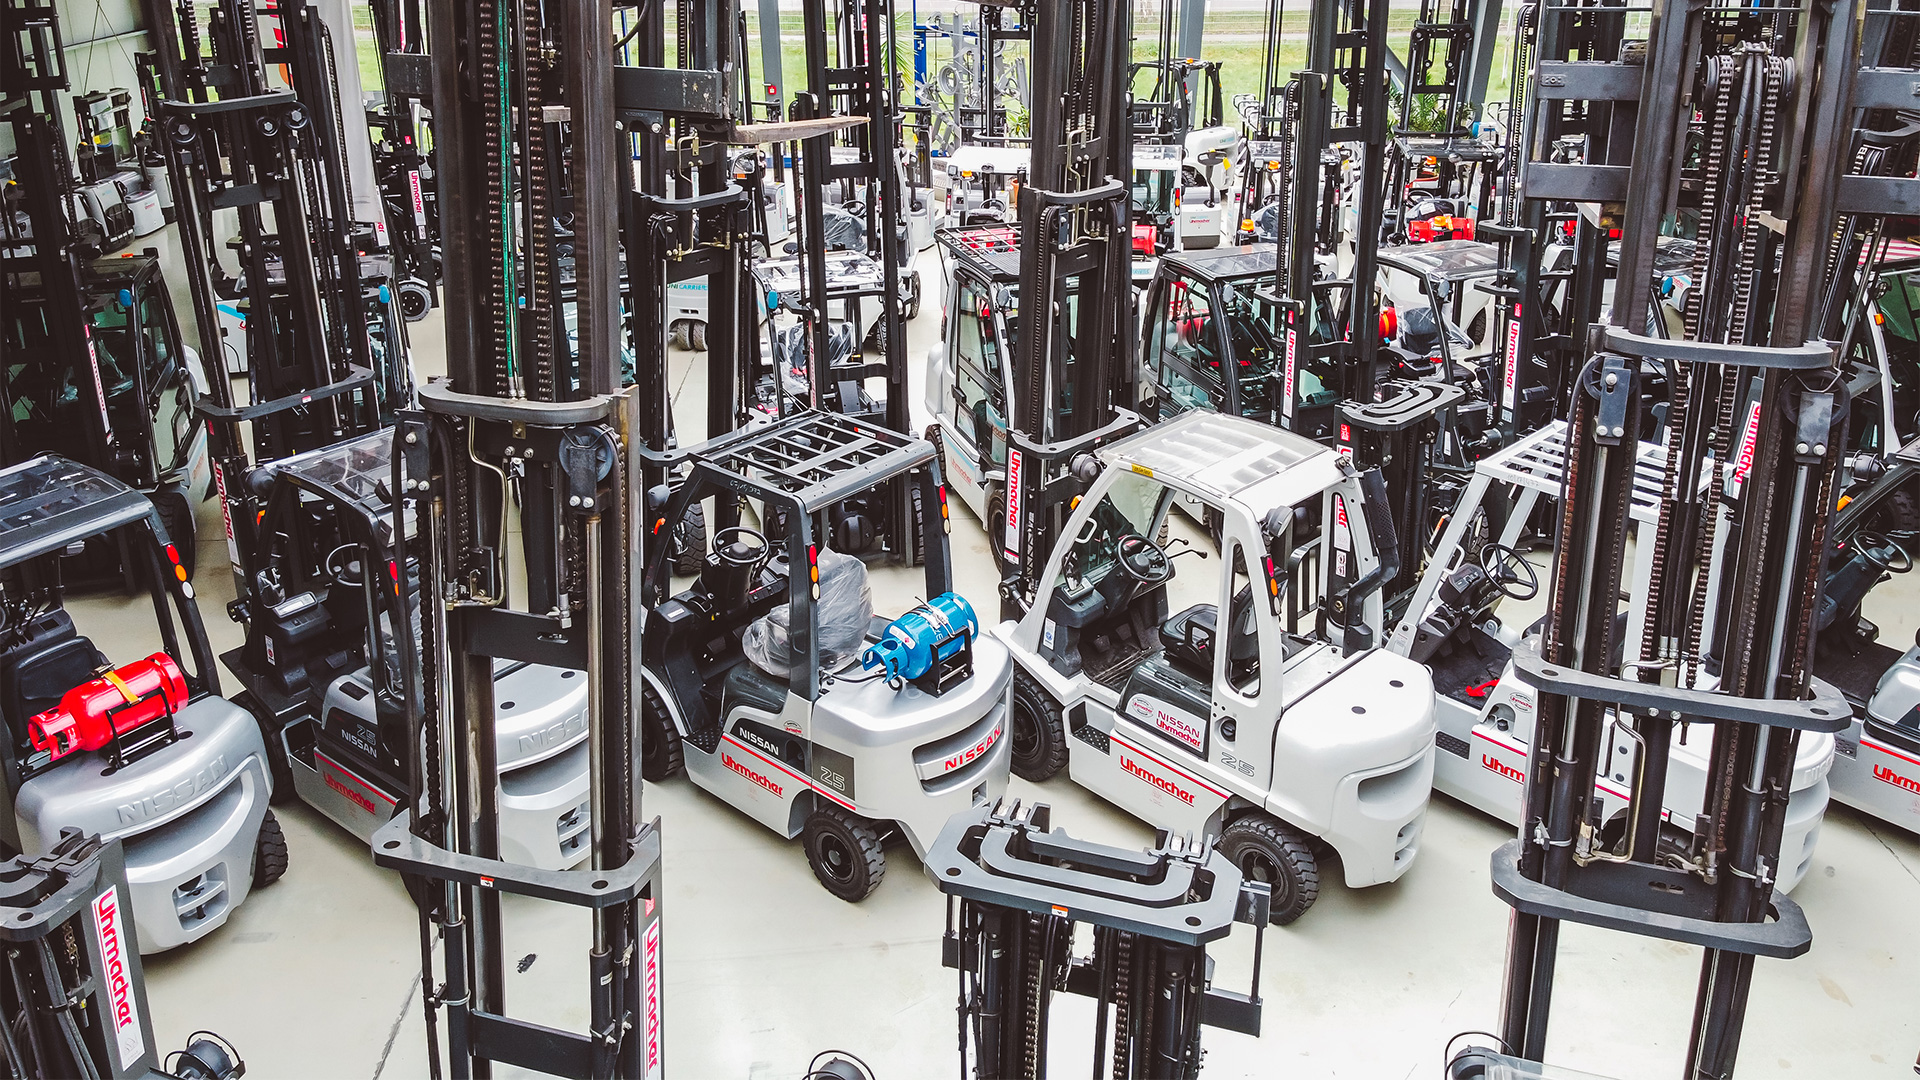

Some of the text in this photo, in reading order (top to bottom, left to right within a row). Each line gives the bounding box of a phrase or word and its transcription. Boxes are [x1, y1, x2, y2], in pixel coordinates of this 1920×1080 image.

[1284, 331, 1296, 398] Uhrmacher
[1506, 322, 1519, 390] Uhrmacher
[1009, 450, 1021, 530] Uhrmacher
[340, 728, 378, 759] NISSAN
[355, 723, 378, 747] 25
[739, 726, 779, 756] NISSAN
[944, 724, 1001, 771] NISSAN
[1155, 718, 1201, 748] Uhrmacher
[1157, 709, 1201, 739] NISSAN
[721, 751, 784, 799] Uhrmacher
[819, 765, 847, 793] 25
[1120, 754, 1196, 806] Uhrmacher
[1220, 751, 1255, 778] 25
[116, 753, 230, 824] NISSAN
[322, 770, 377, 814] Uhrmacher
[98, 890, 132, 1027] Uhrmacher
[646, 921, 660, 1071] Uhrmacher
